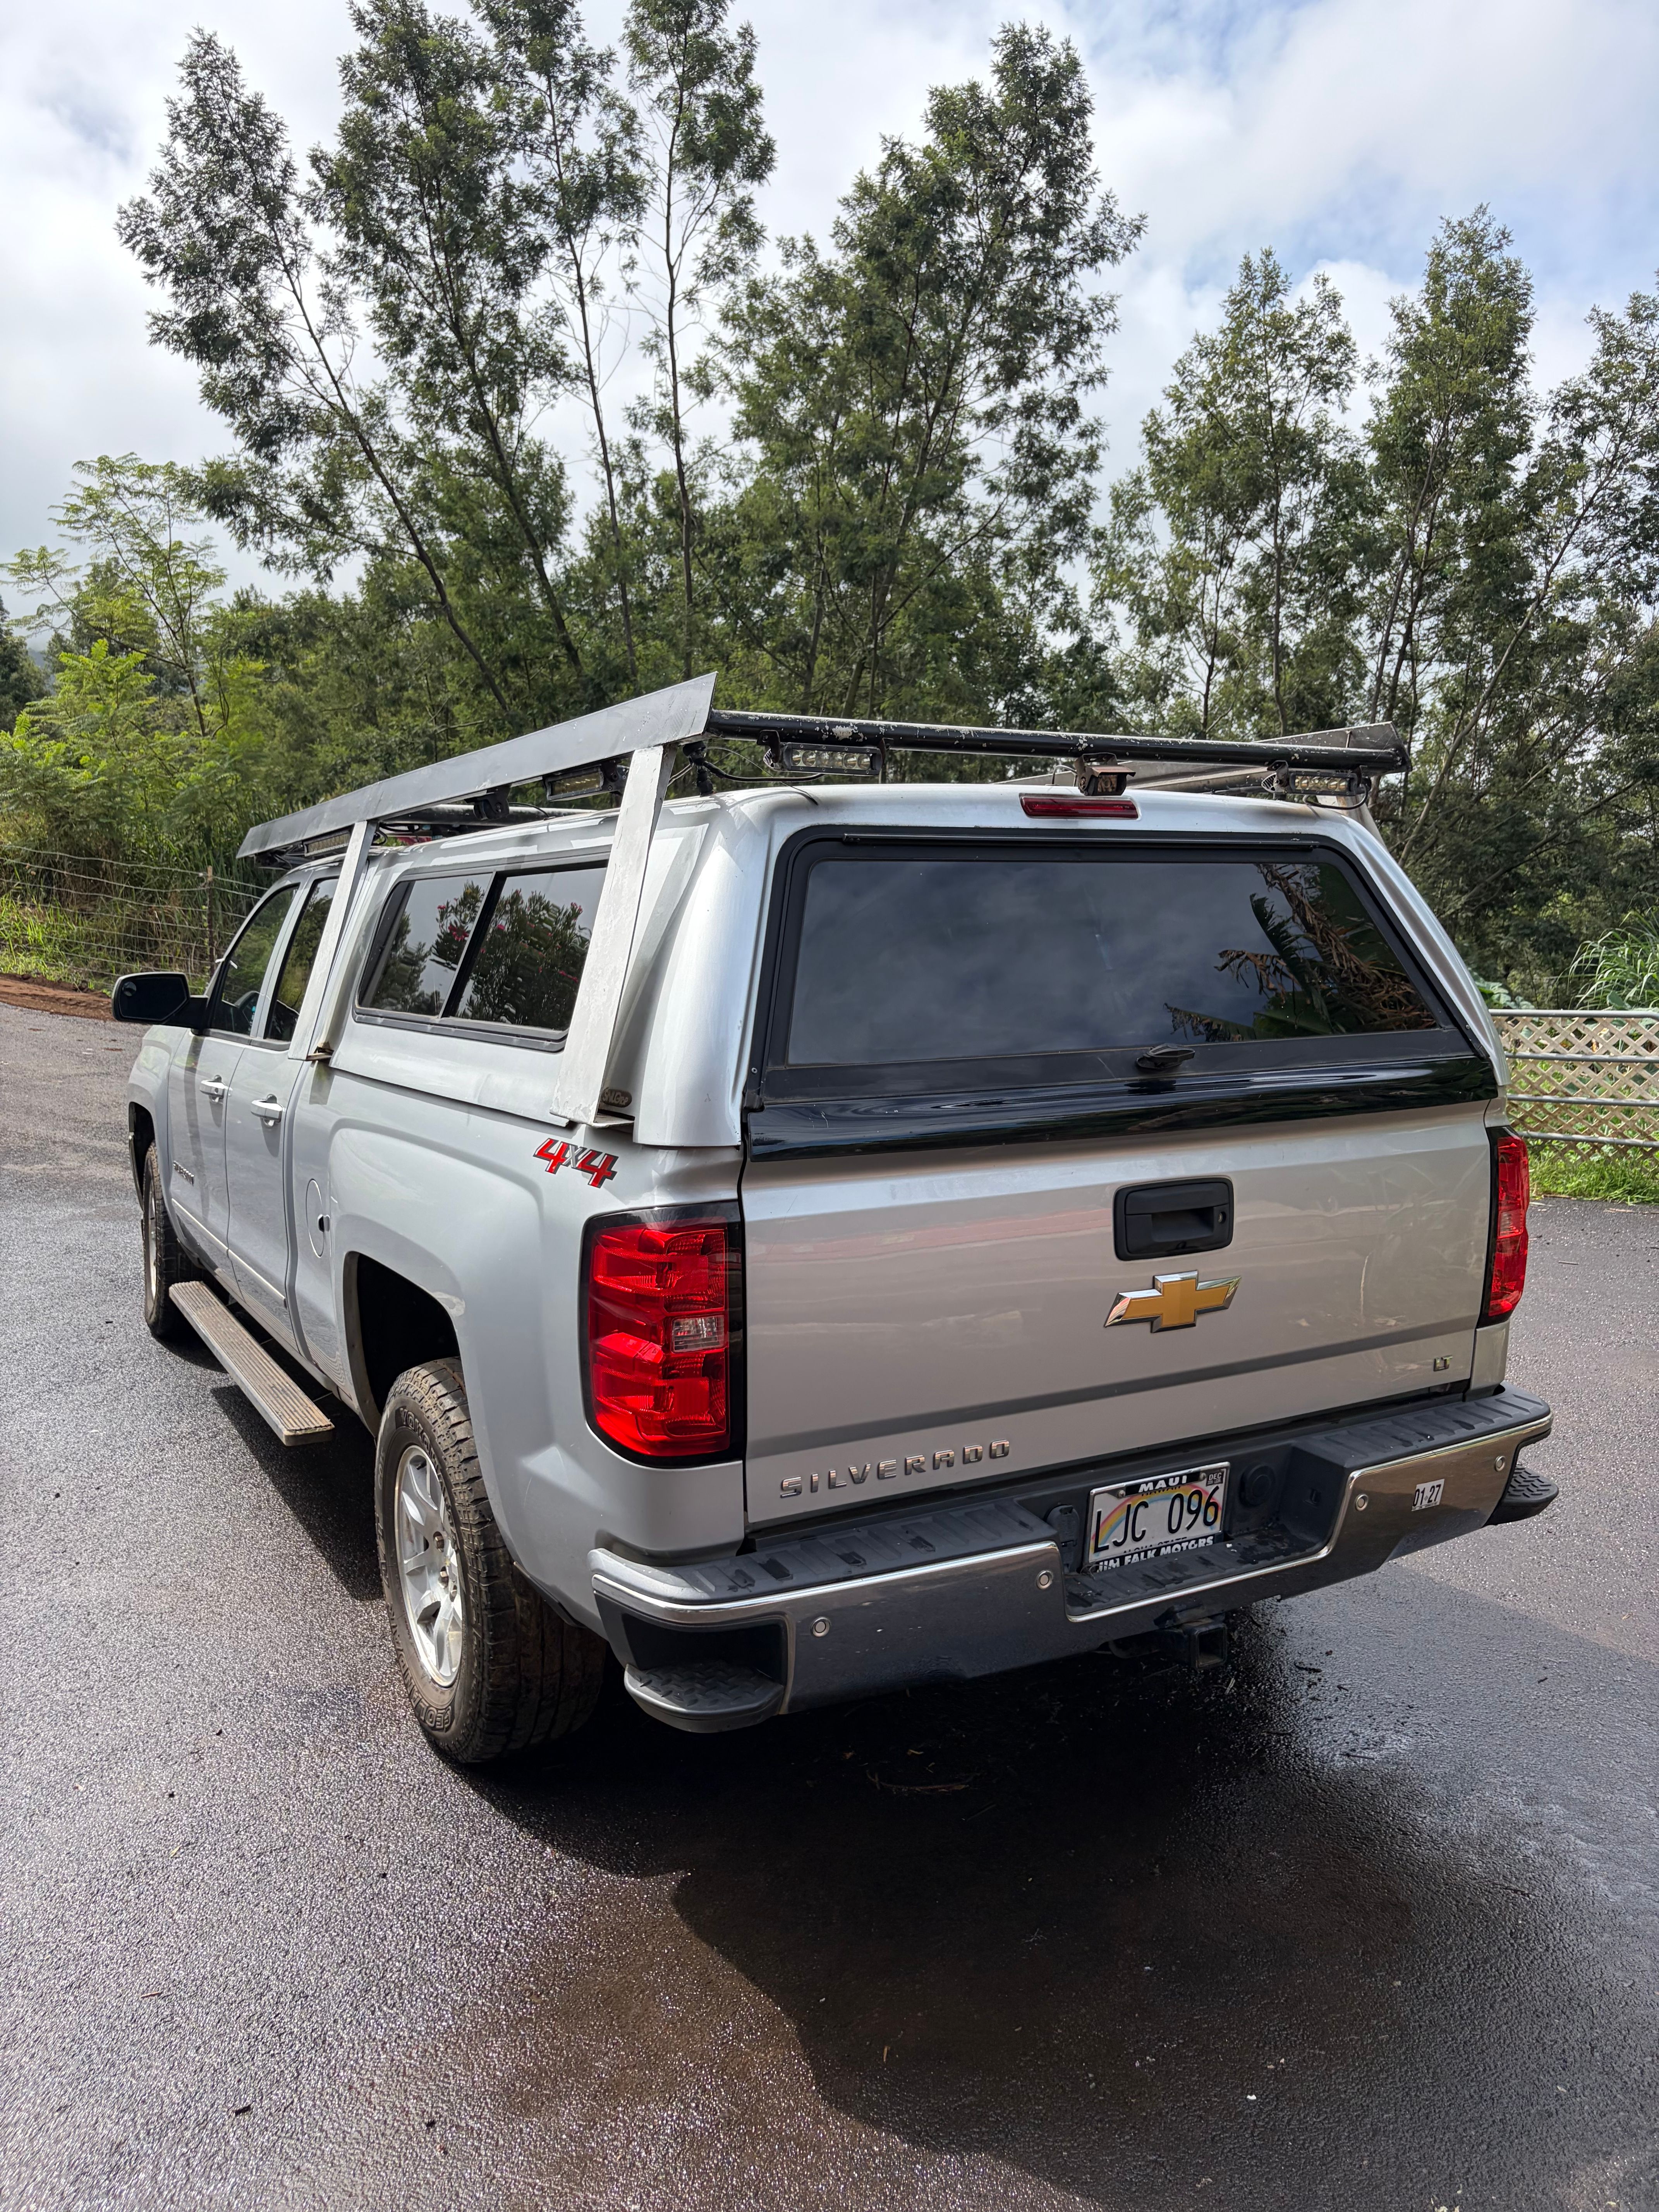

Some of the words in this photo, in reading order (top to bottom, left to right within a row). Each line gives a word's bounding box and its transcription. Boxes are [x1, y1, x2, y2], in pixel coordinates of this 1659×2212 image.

[1434, 1355, 1453, 1371] LT
[780, 1439, 1009, 1498] SILVERADO
[1208, 1472, 1222, 1480] DEC
[1138, 1475, 1187, 1493] MAUI
[1093, 1501, 1149, 1553] LJC
[1167, 1486, 1219, 1534] 096
[1097, 1558, 1120, 1572] JIM
[1124, 1549, 1157, 1565] FALK
[1159, 1536, 1214, 1556] MOTORS
